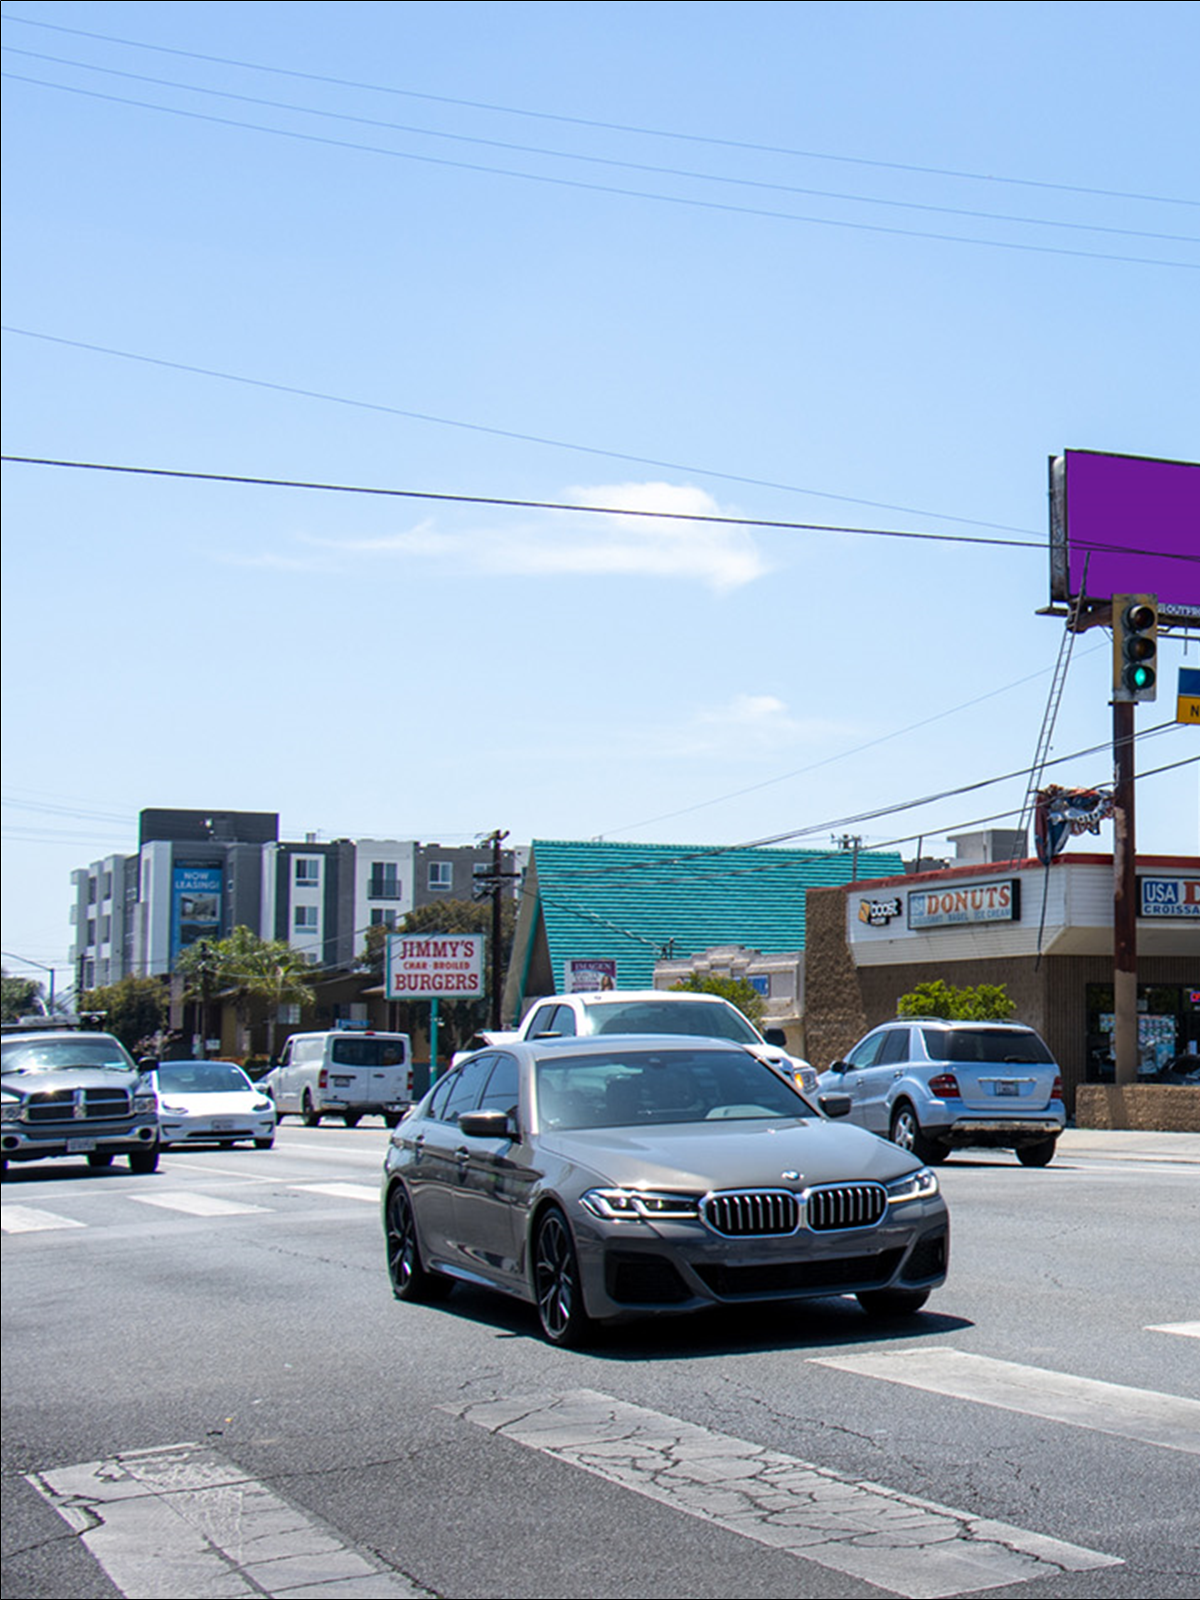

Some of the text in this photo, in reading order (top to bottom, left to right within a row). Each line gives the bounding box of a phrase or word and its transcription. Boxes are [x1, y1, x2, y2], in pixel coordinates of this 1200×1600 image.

[183, 872, 210, 880] NOW
[927, 885, 1010, 915] DONUTS
[1145, 883, 1176, 903] USA
[870, 899, 900, 916] boost
[400, 940, 475, 960] JIMMY'S
[403, 961, 470, 970] CHAR BROILED
[394, 973, 479, 991] BURGERS
